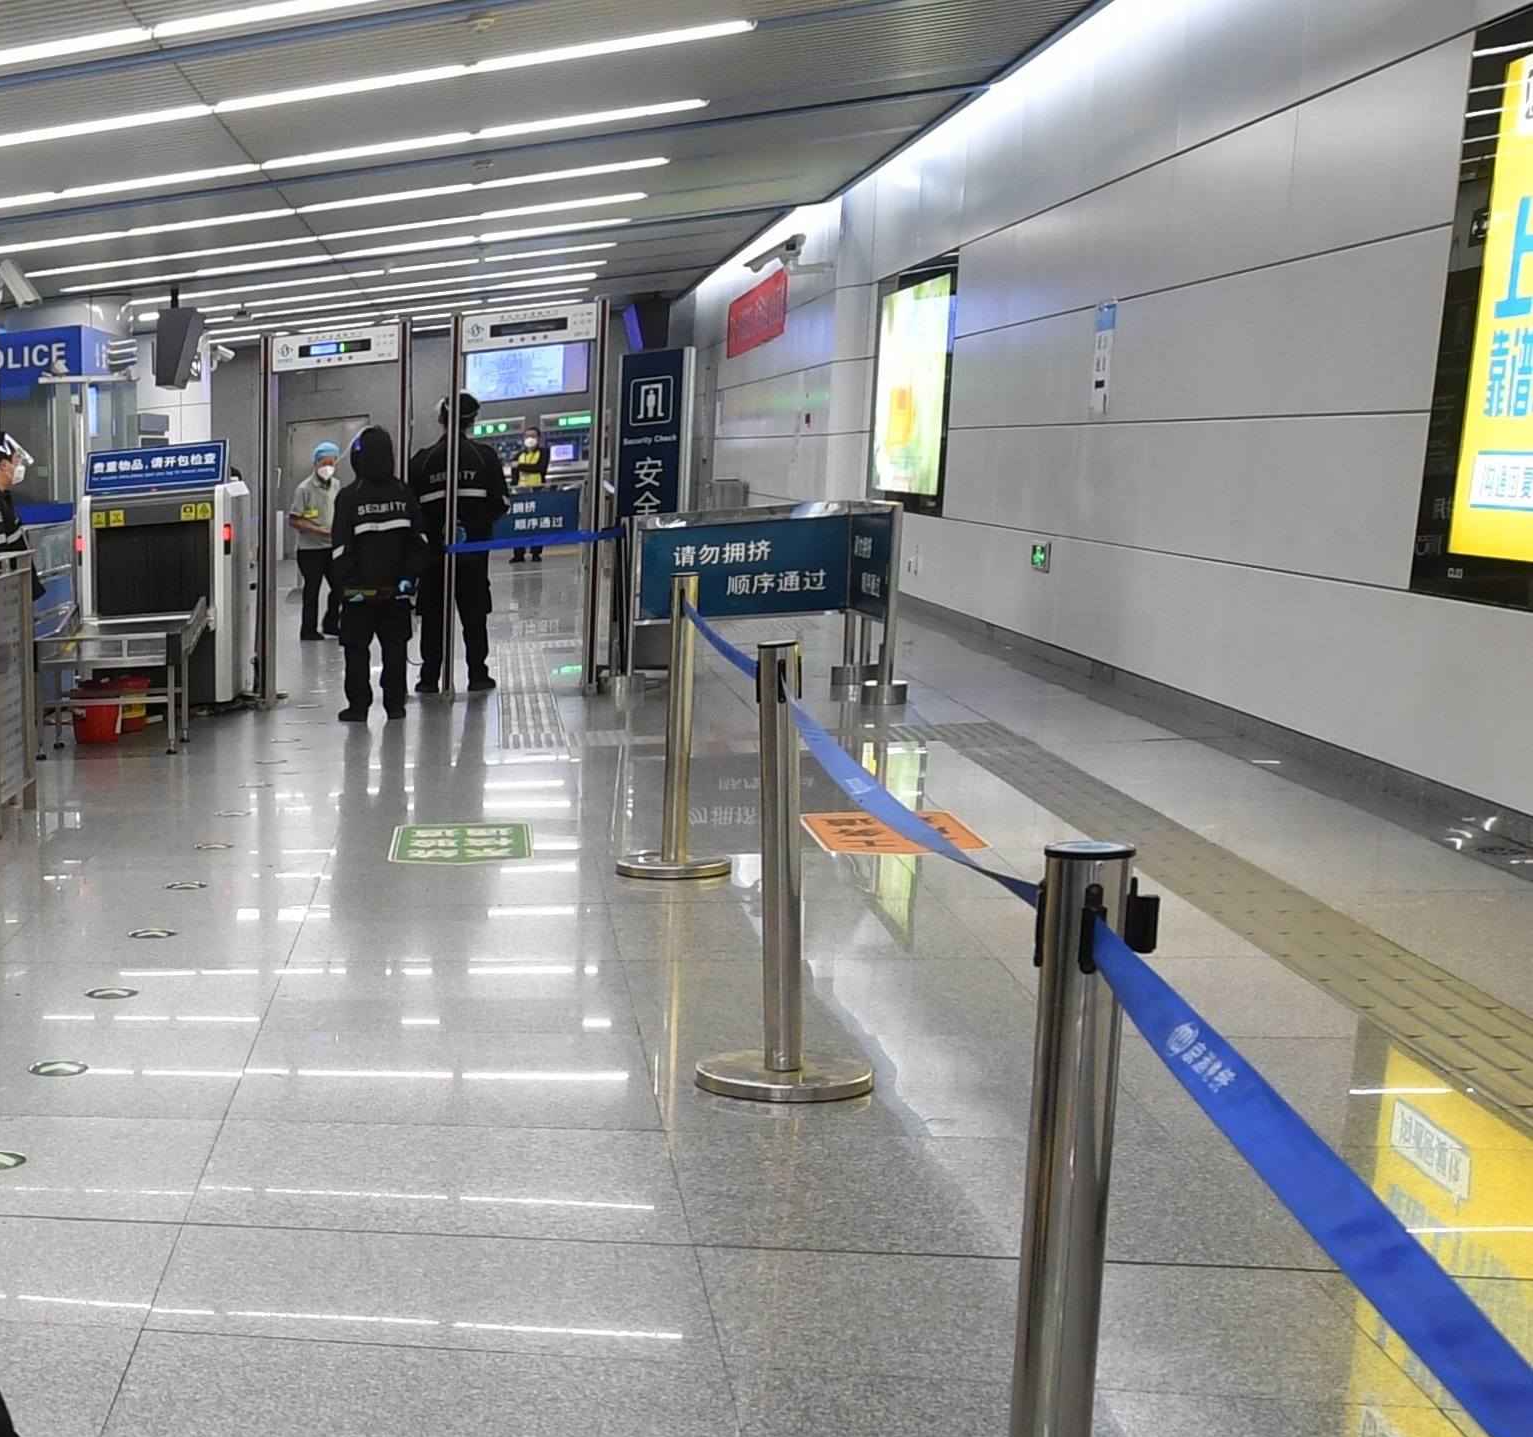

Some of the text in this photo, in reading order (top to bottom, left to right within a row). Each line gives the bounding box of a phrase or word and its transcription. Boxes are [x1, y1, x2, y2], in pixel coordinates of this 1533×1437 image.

[633, 456, 663, 516] 安全
[357, 501, 407, 516] SECURITY
[514, 516, 563, 530] 顺序通过
[673, 539, 772, 568] 请勿拥挤
[726, 568, 827, 597] 顺序通过
